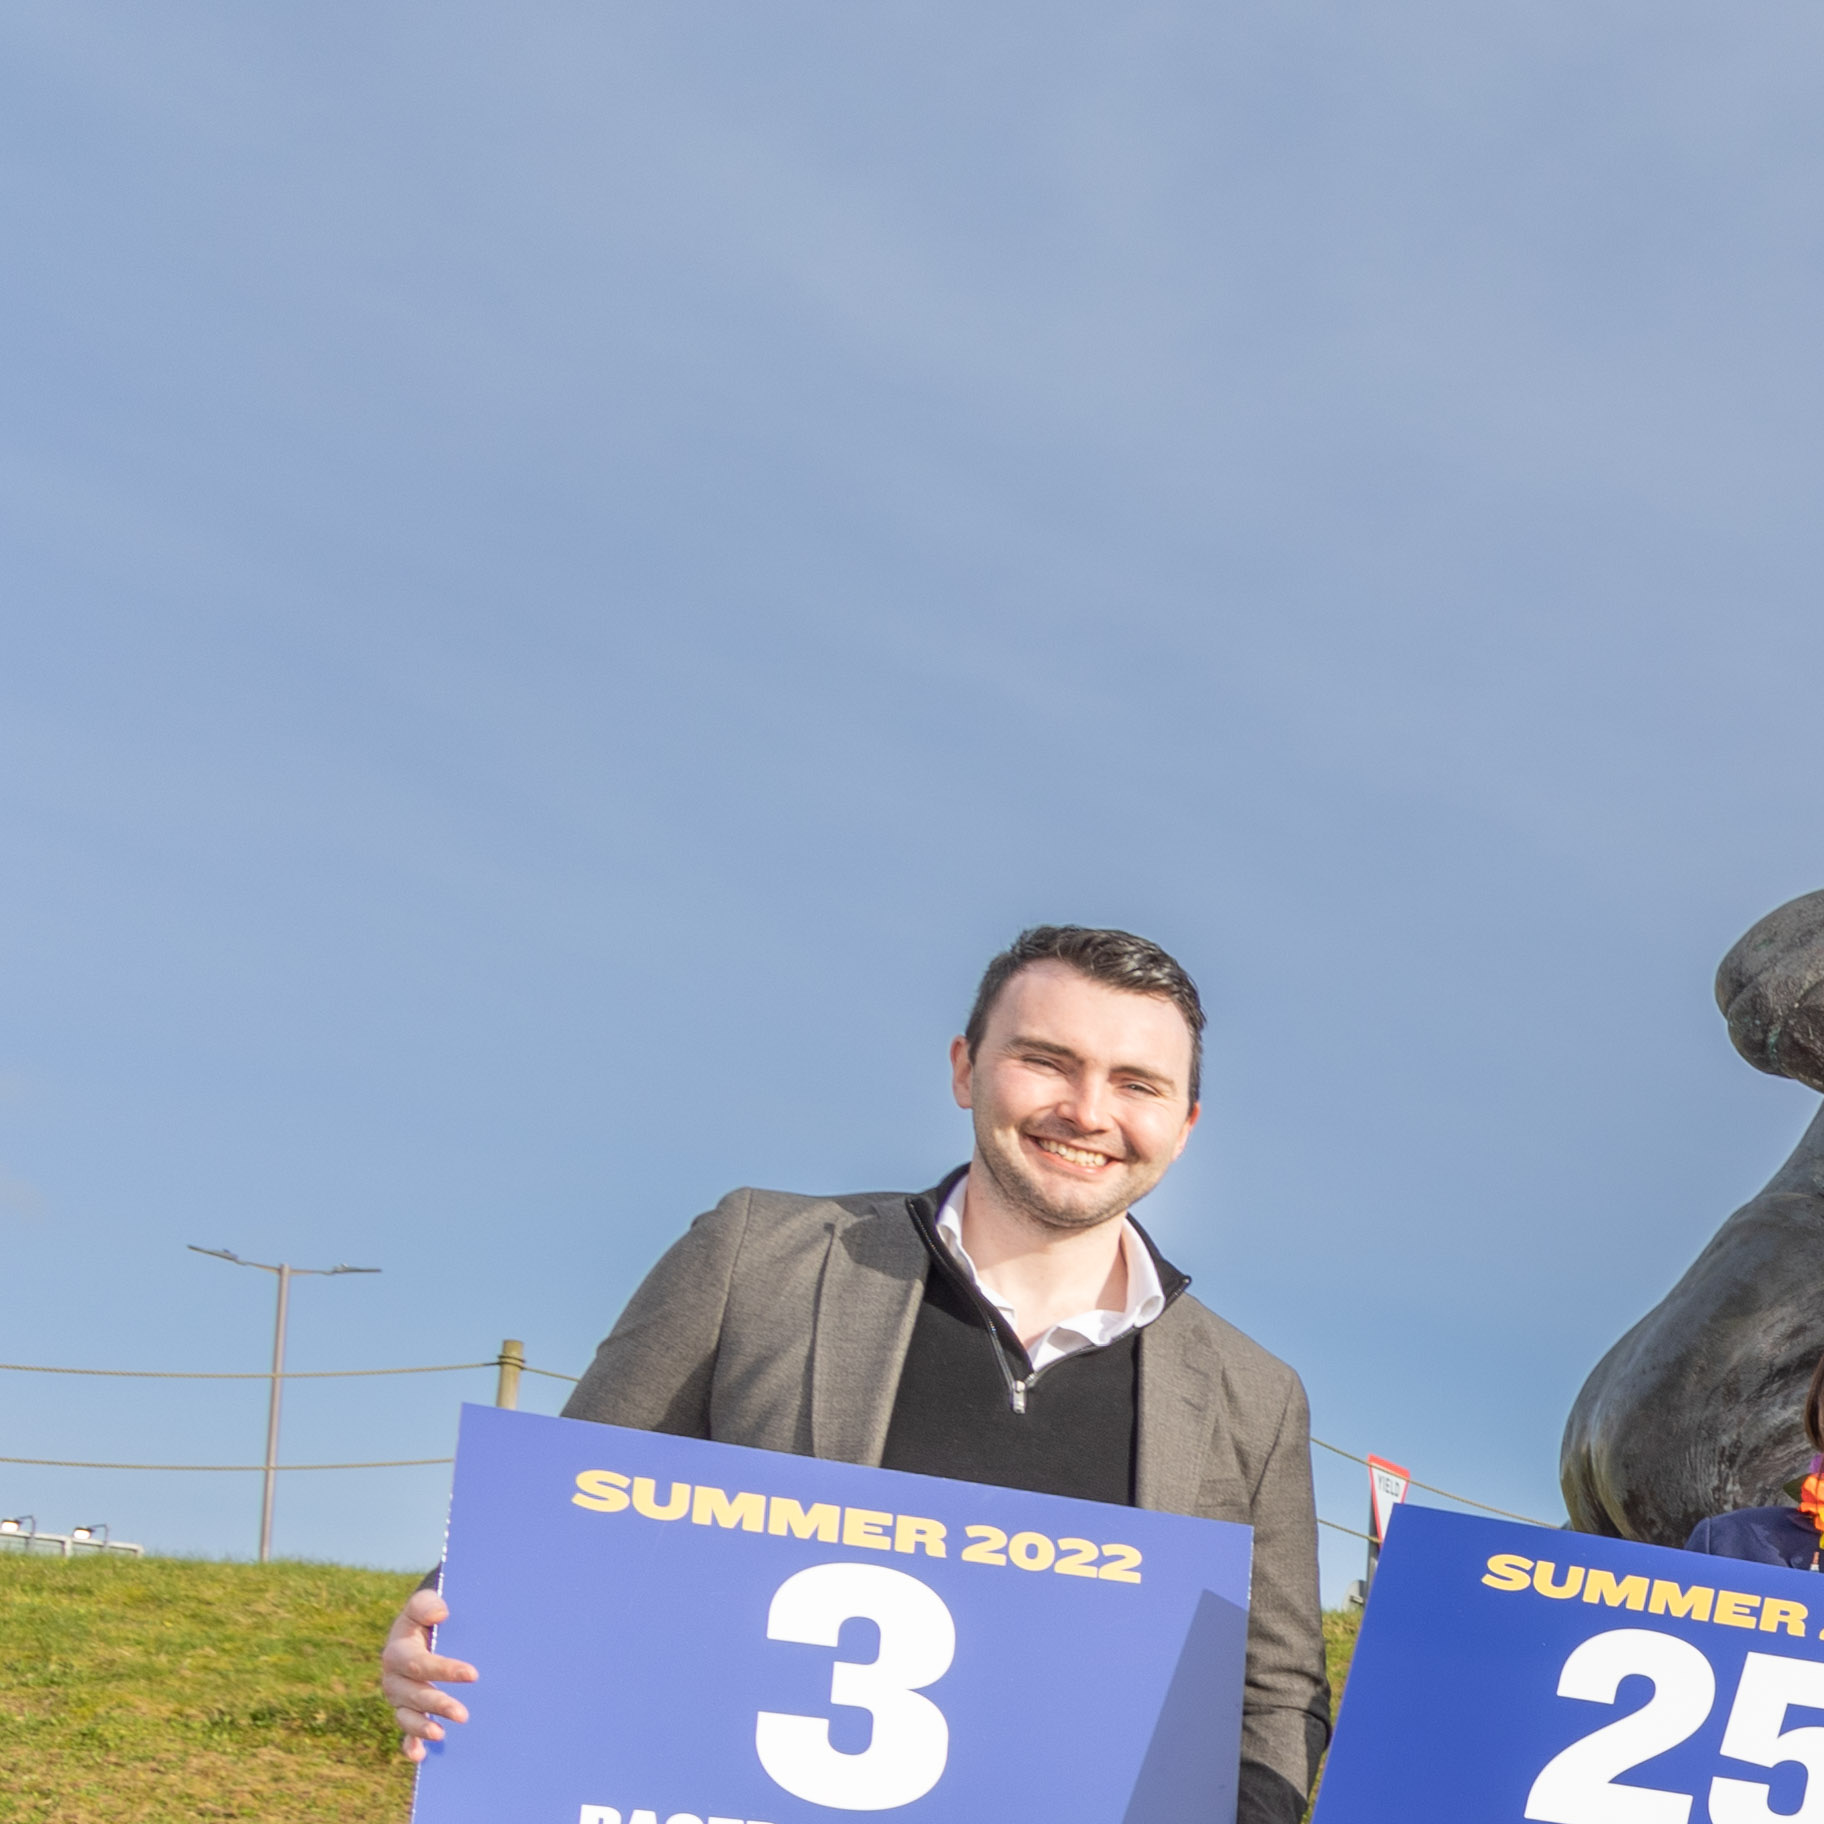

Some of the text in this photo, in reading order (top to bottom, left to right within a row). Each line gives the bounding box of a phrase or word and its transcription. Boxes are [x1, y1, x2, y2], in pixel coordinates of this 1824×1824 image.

[571, 1468, 1142, 1585] SUMMER 2022
[1481, 1553, 1811, 1638] SUMMER
[755, 1562, 956, 1810] 3
